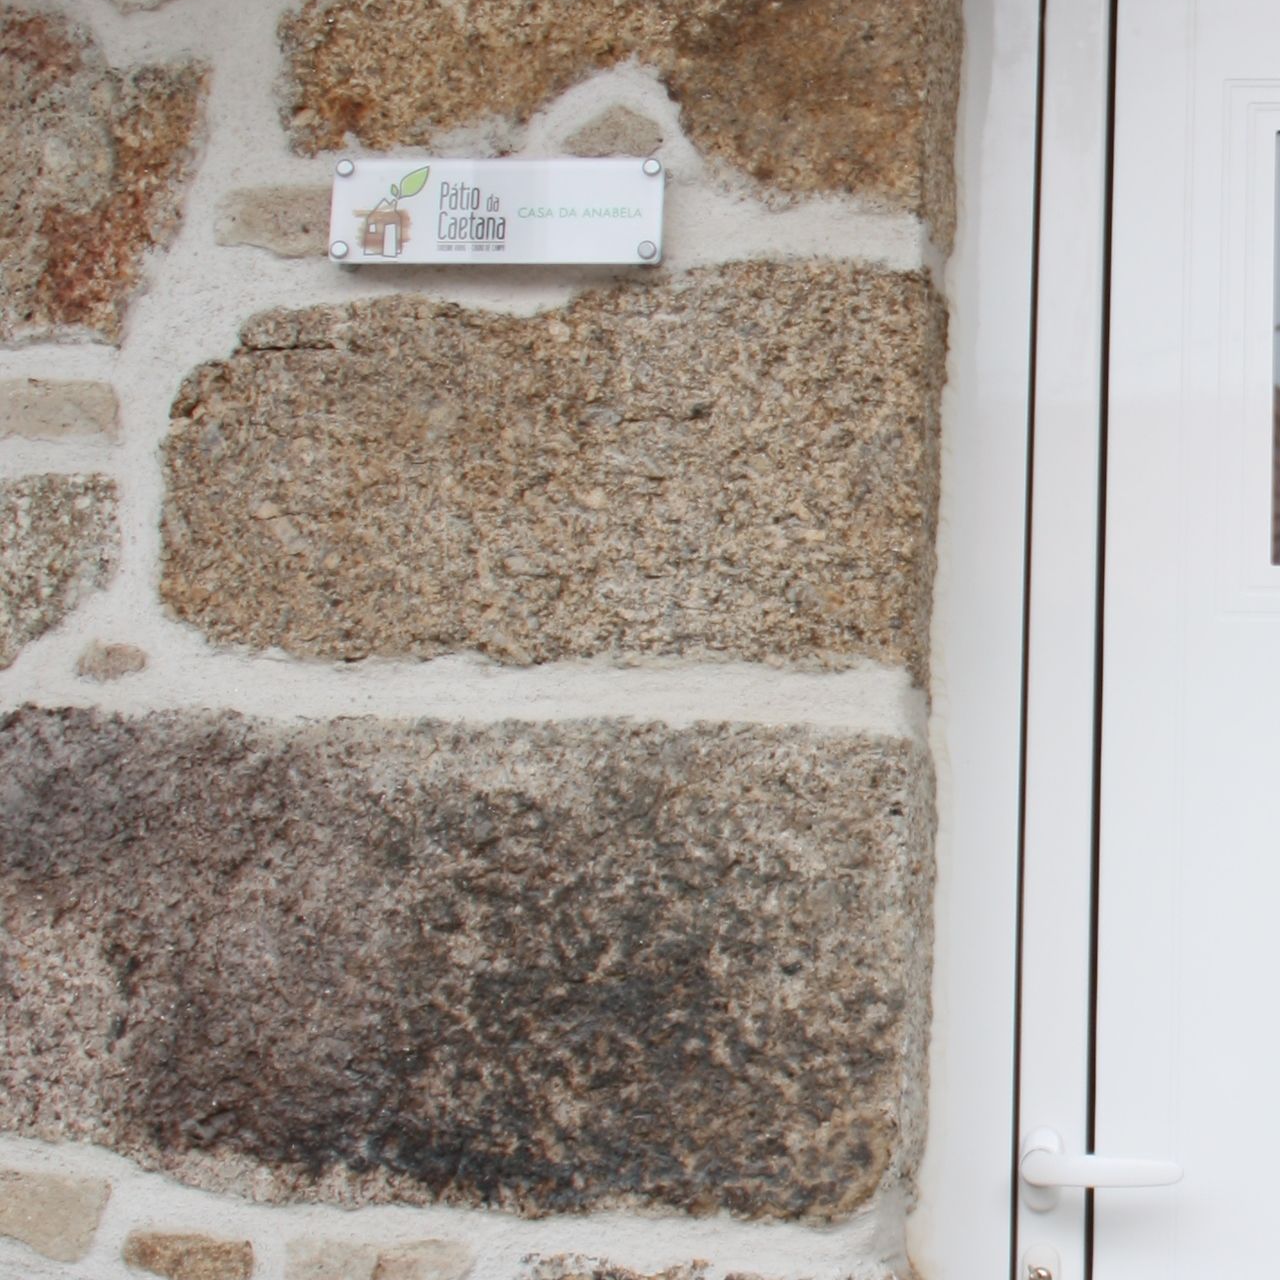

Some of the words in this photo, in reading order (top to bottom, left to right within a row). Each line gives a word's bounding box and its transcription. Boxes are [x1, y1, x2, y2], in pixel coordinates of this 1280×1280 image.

[440, 181, 480, 210] Pátio
[486, 194, 500, 212] da
[438, 211, 506, 240] Caetana
[517, 207, 554, 218] CASA
[559, 207, 577, 218] DA
[583, 207, 642, 218] ANABELA
